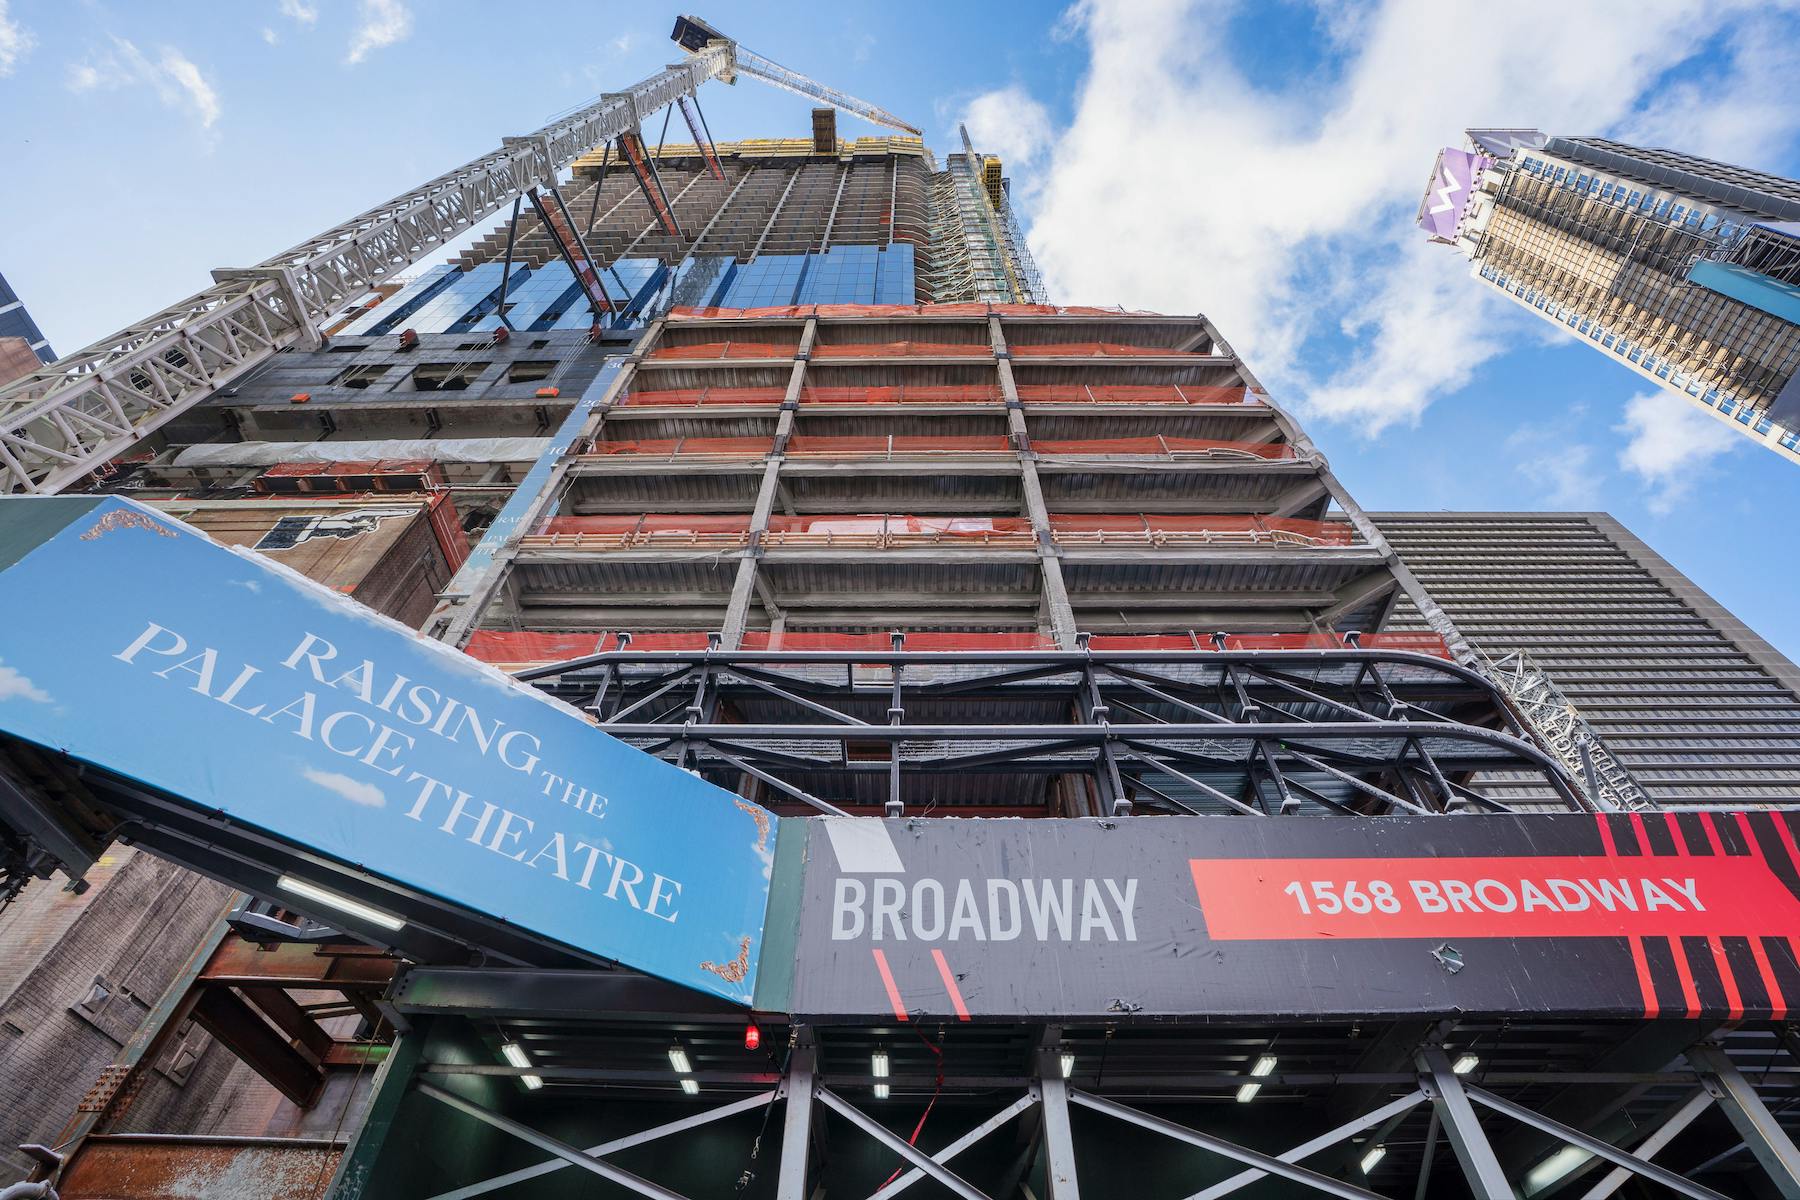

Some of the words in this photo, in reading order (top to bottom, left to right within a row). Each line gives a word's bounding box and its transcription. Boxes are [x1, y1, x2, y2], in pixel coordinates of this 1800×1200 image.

[549, 447, 568, 455] 10
[281, 632, 541, 778] RAISING
[542, 771, 608, 819] THE
[112, 622, 415, 777] PALACE
[404, 771, 682, 923] THEATRE
[831, 877, 1139, 941] BROADWAY
[1284, 880, 1401, 915] 1568
[1409, 878, 1706, 913] BROADWAY
